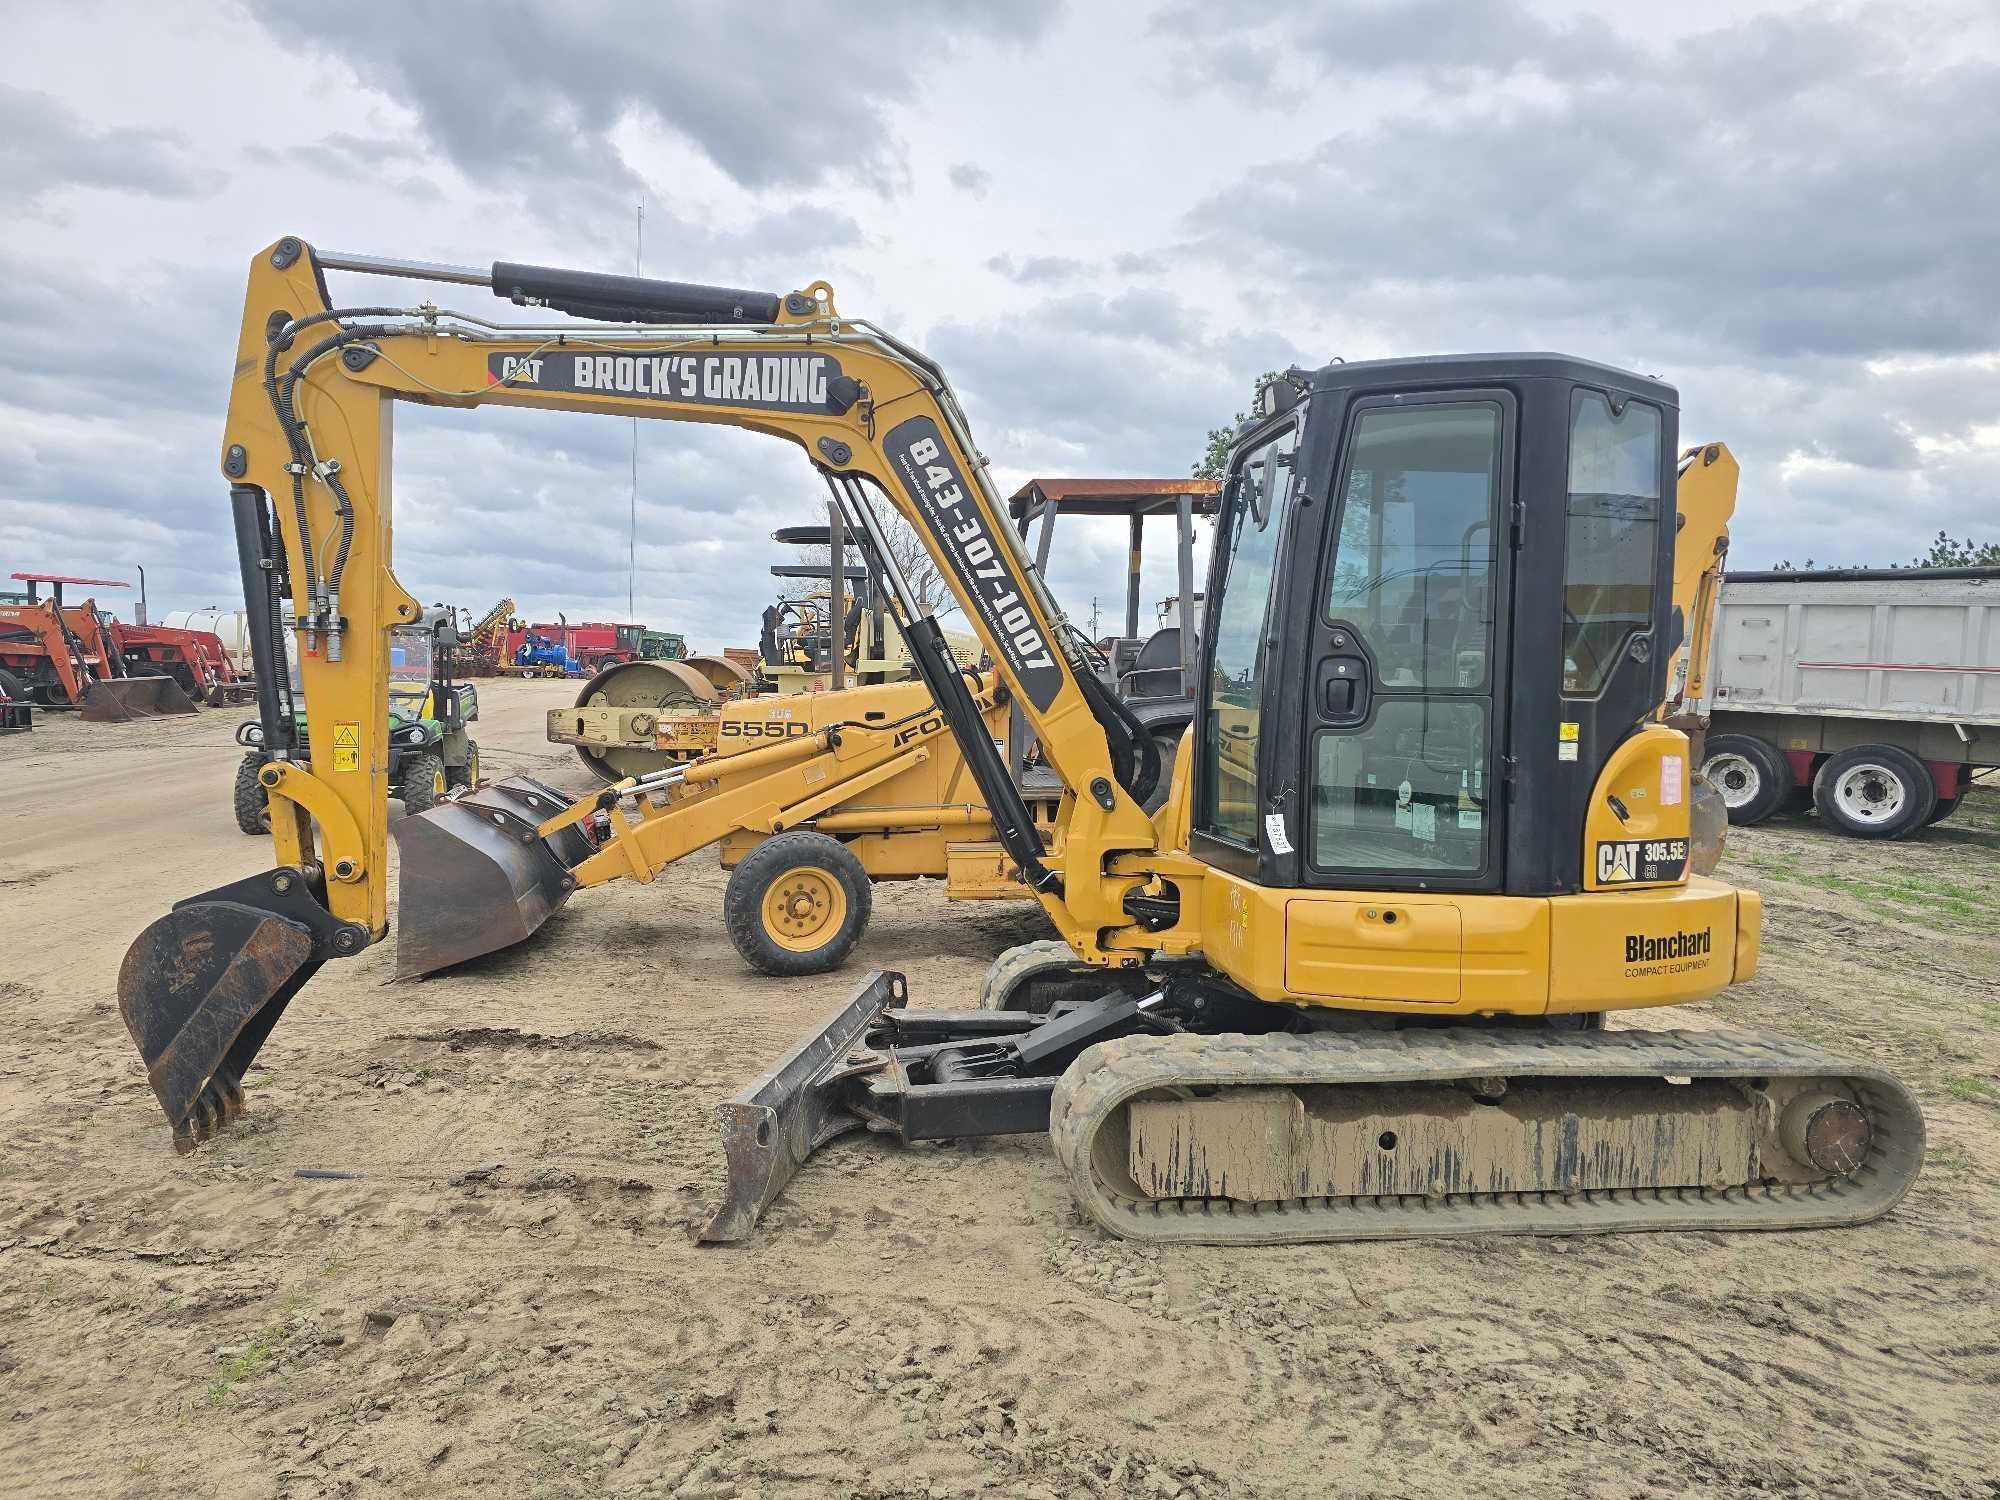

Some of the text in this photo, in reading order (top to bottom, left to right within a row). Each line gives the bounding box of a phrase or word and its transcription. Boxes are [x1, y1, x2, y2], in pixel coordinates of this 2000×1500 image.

[502, 356, 544, 384] CAT
[575, 356, 827, 404] BROCK'S GRADING
[909, 437, 1055, 669] 843-307-1007
[721, 720, 809, 738] 555D
[1598, 843, 1640, 882] CAT
[1625, 926, 1711, 963] Blanchard
[1624, 958, 1710, 978] COMPACT EQUIPMENT
